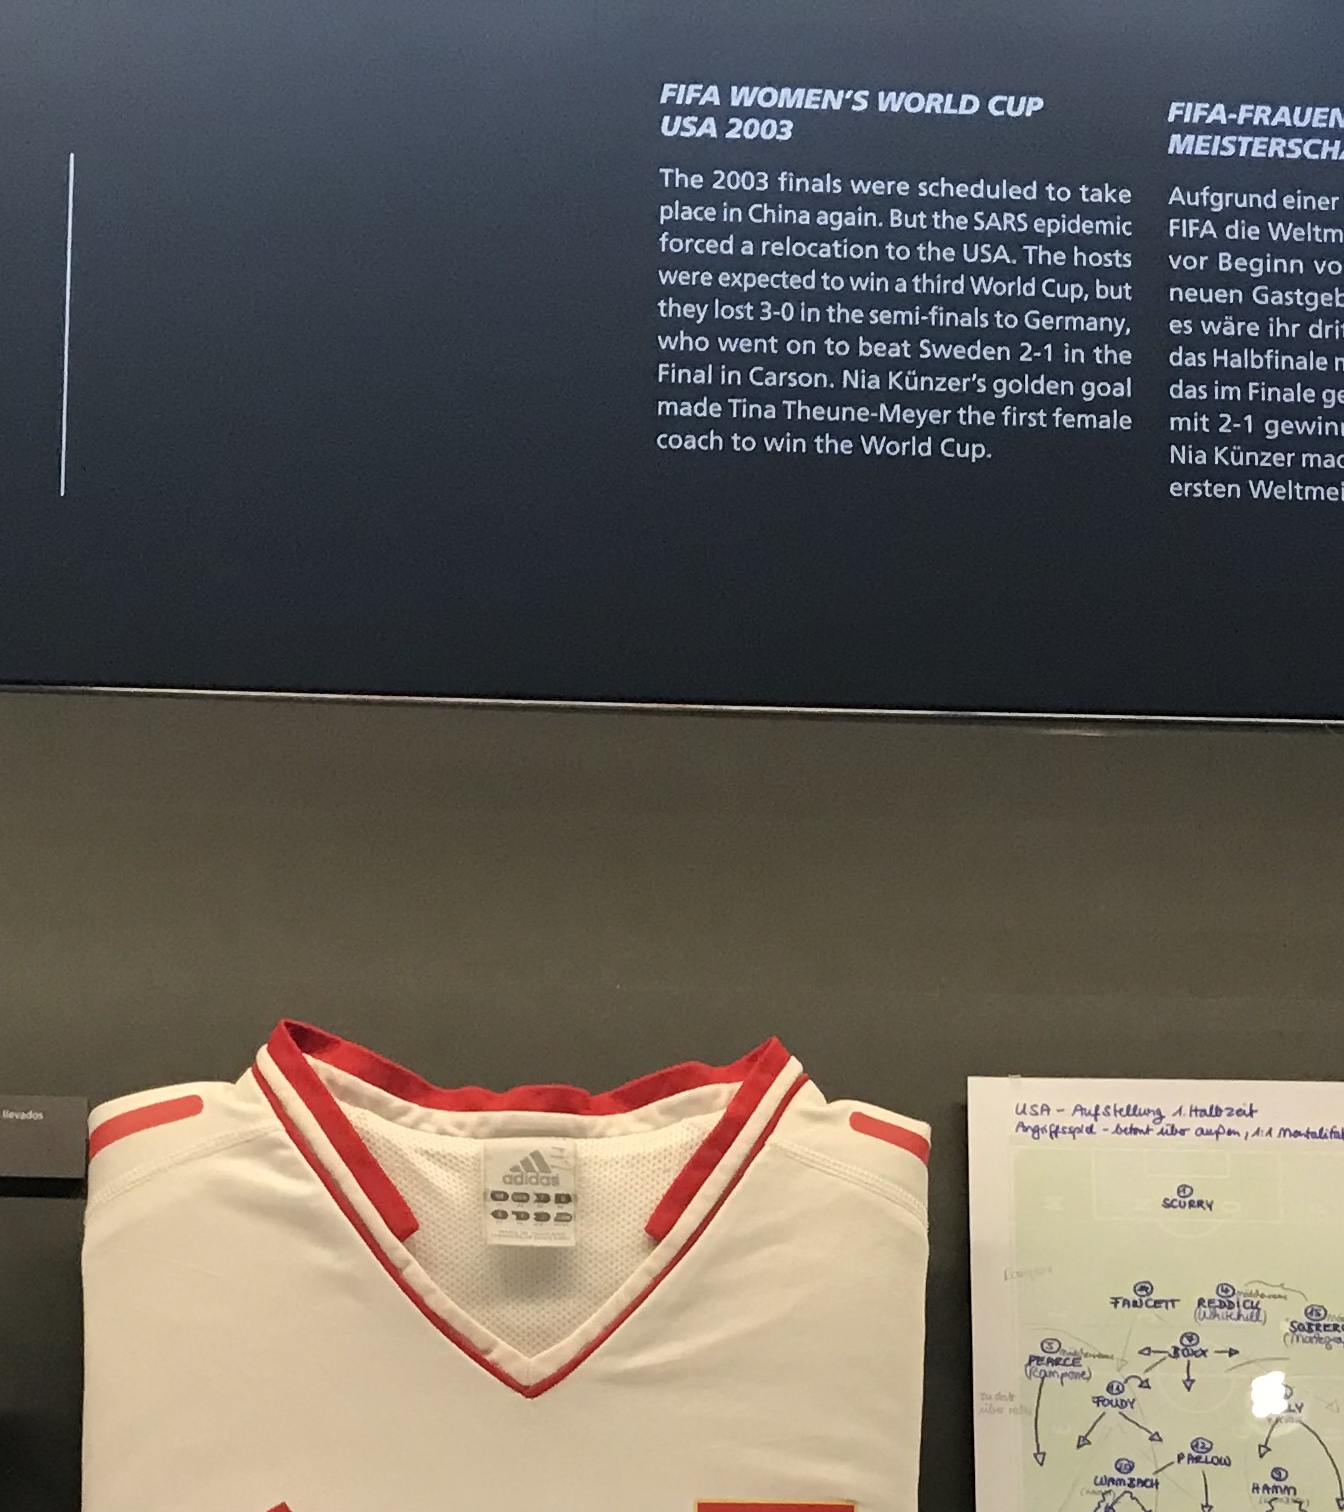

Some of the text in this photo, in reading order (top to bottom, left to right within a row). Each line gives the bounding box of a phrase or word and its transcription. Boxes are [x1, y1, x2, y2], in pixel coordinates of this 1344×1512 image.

[659, 82, 1044, 117] FIFA WOMEN'S WORLD CUP
[660, 114, 793, 141] USA 2003
[658, 167, 1131, 204] The 2003 finals were scheduled to take
[1015, 1104, 1051, 1117] USA
[502, 1173, 560, 1186] adidas
[1162, 1198, 1214, 1211] SCURRY
[1028, 1355, 1082, 1368] PEARCE
[1177, 1453, 1232, 1467] PARLOW
[1251, 1482, 1297, 1496] HAMM
